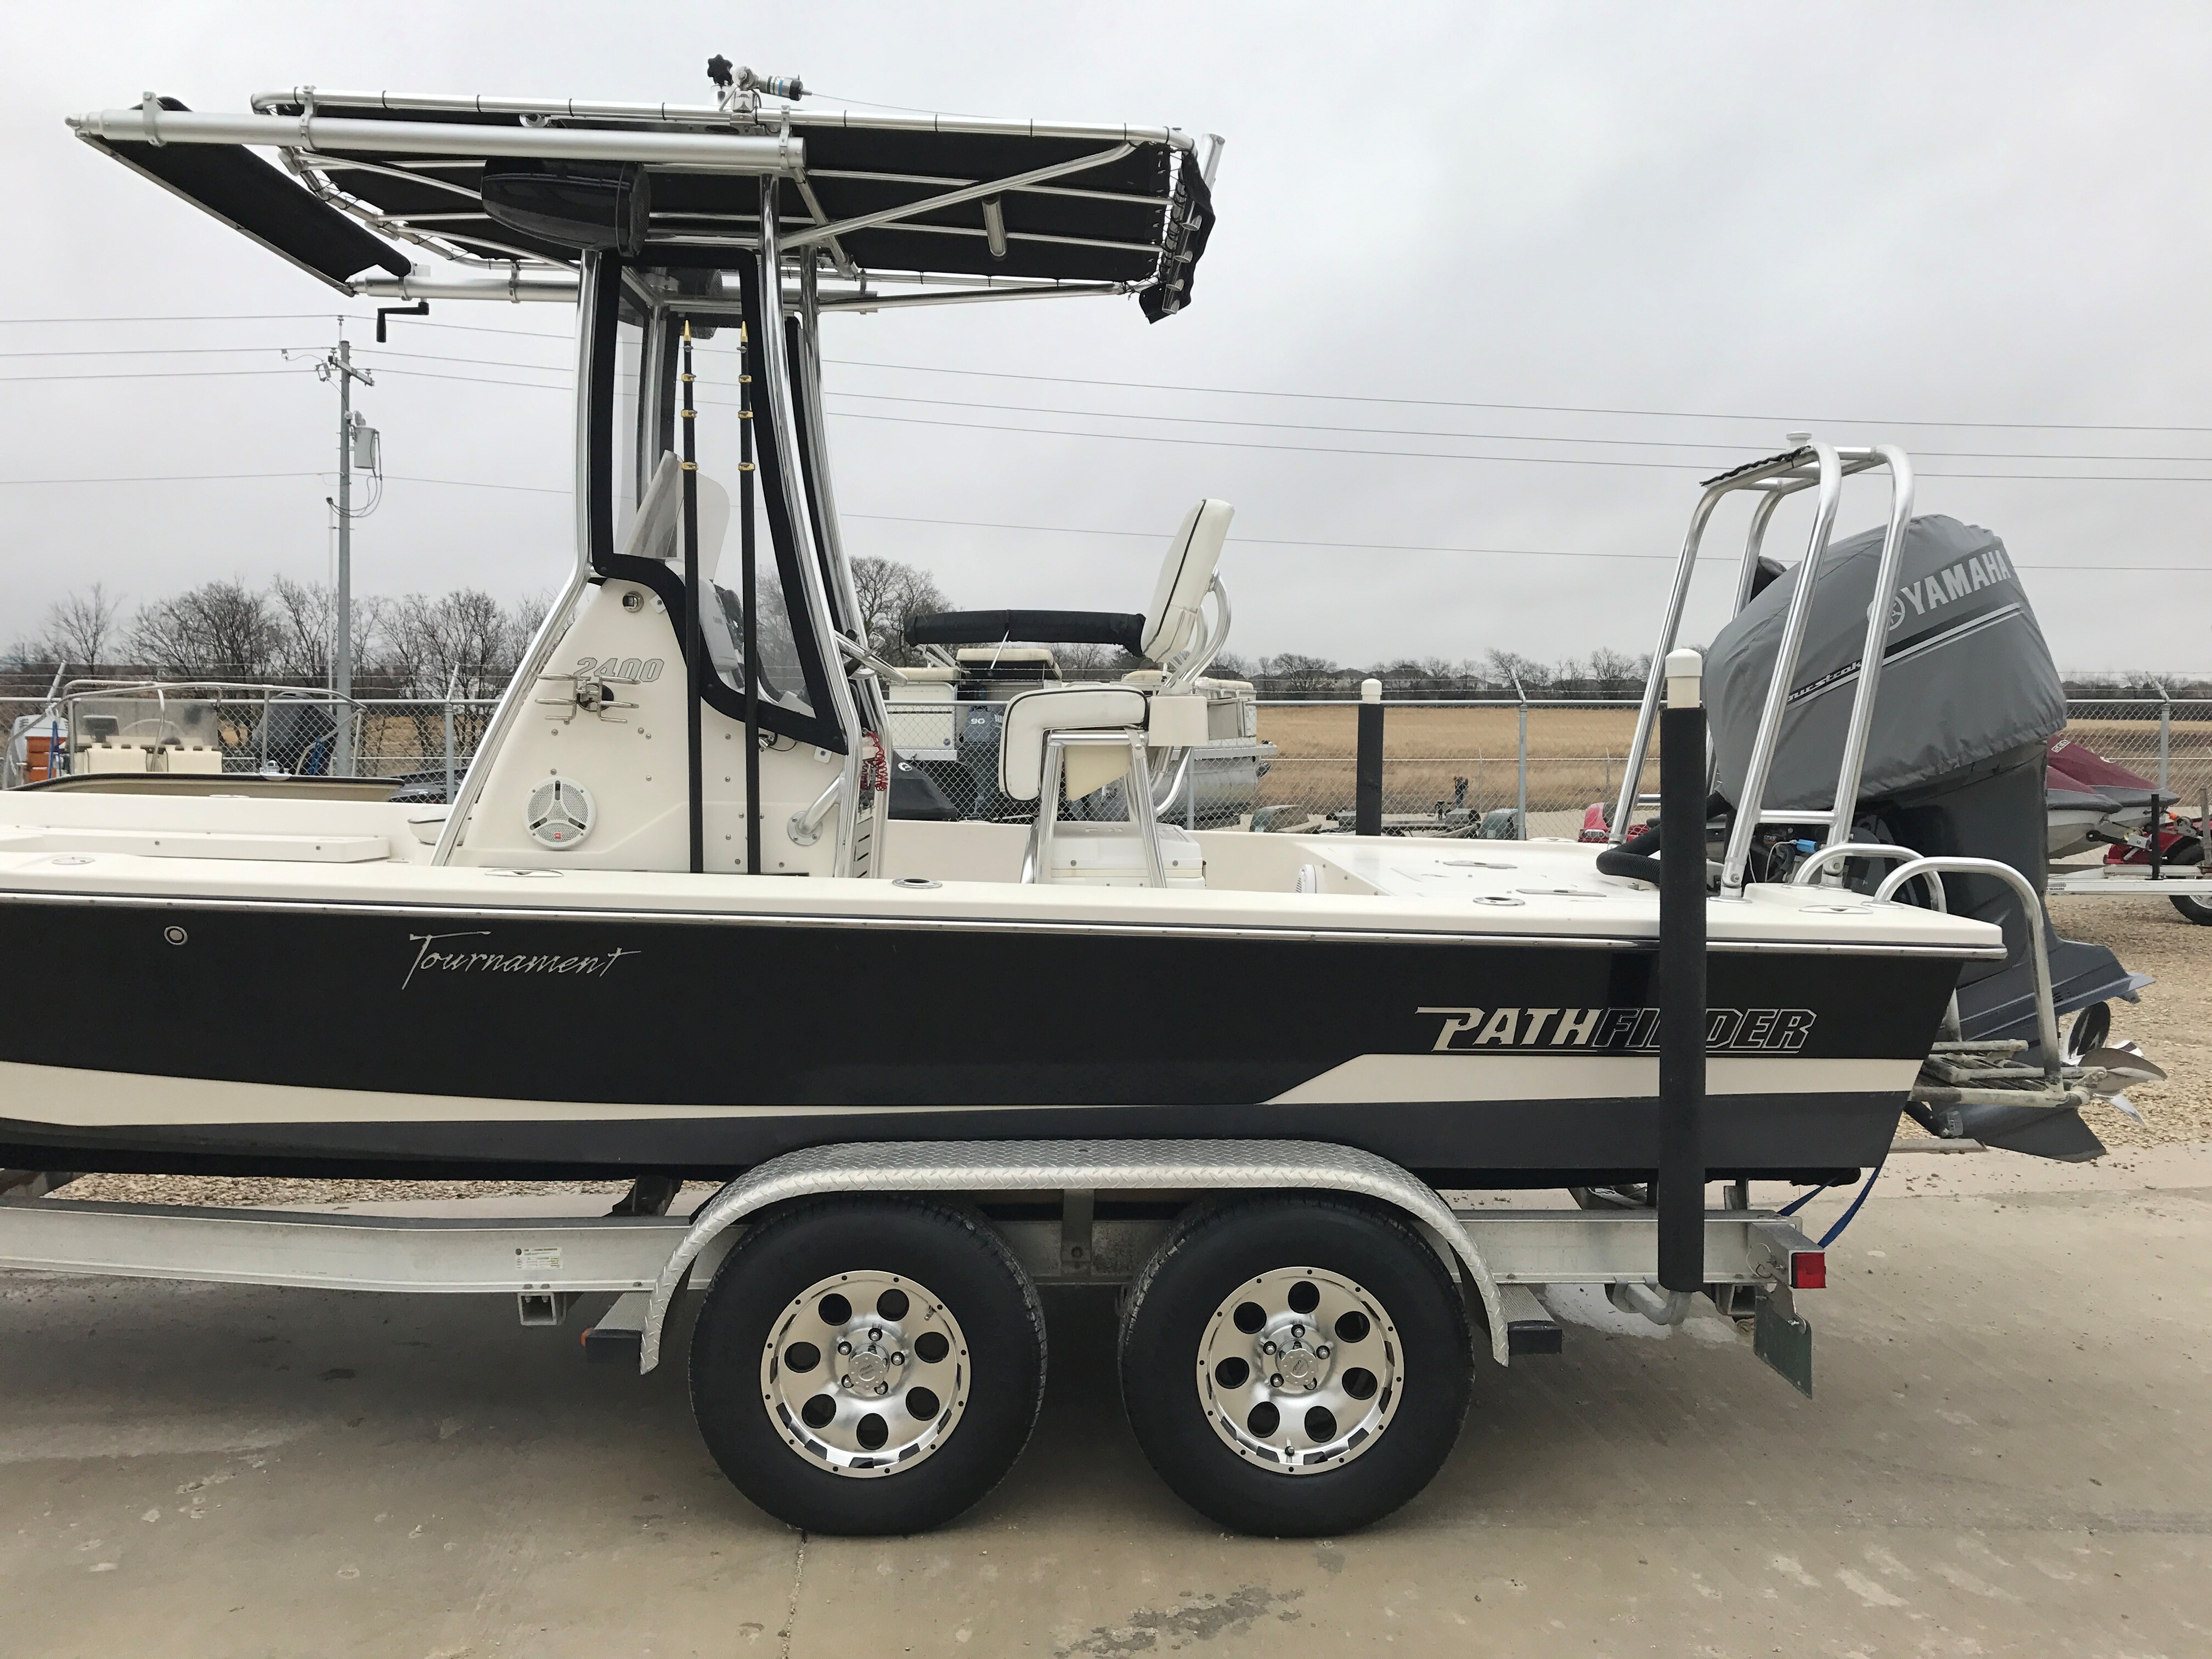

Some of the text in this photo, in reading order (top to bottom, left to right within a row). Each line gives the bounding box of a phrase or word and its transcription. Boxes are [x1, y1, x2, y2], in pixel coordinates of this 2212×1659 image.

[1901, 550, 2012, 615] YAMAHA
[574, 657, 664, 682] 2400
[402, 930, 641, 990] Tournament
[1415, 1007, 1817, 1053] PATHFIDER
